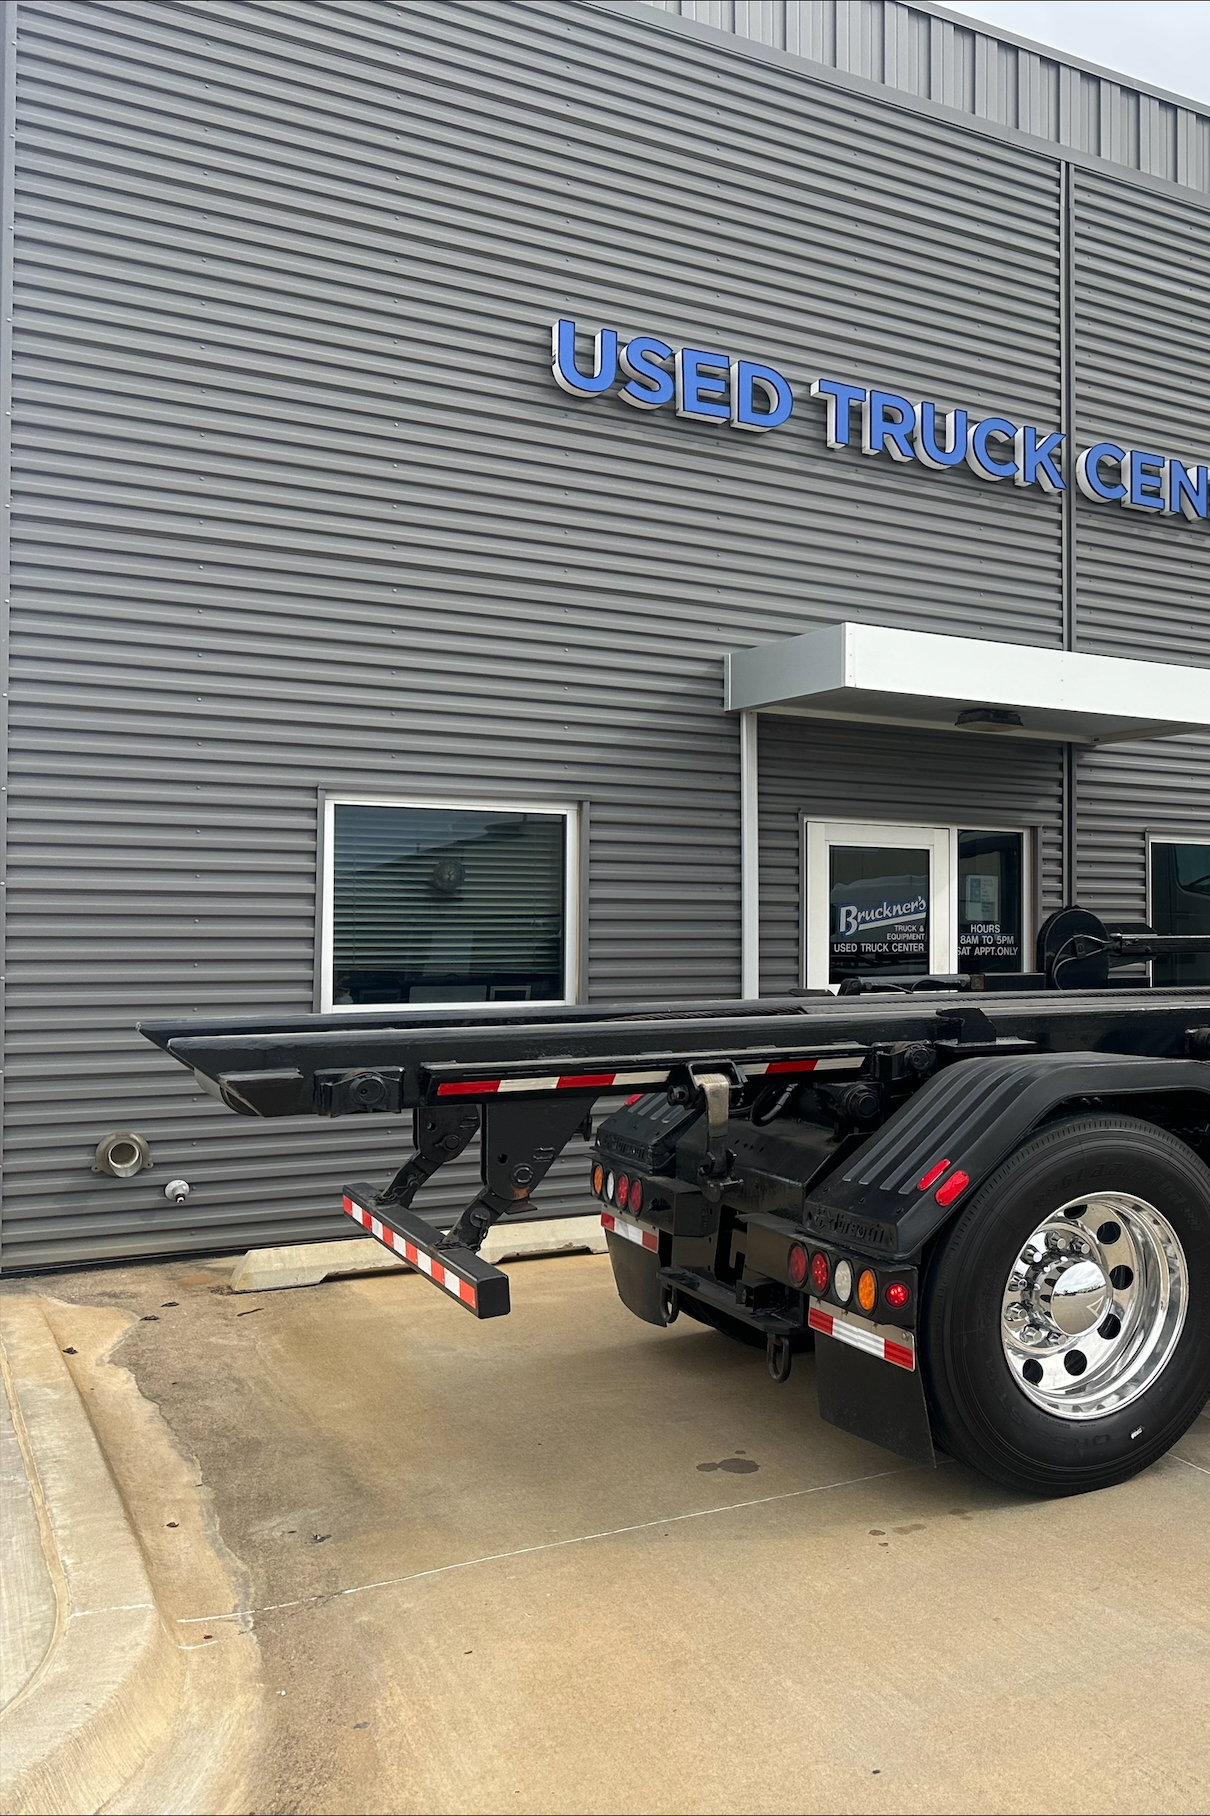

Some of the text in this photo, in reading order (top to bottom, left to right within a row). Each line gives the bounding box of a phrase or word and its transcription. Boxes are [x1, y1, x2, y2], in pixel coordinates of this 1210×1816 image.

[551, 318, 793, 433] USED
[810, 378, 1066, 492] TRUCK
[839, 896, 926, 936] Bruckner's
[894, 925, 917, 933] TRUCK
[970, 924, 1001, 934] HOURS
[886, 932, 925, 941] EQUIPMENT
[960, 935, 1014, 945] 8AM TO 5PM
[834, 943, 924, 953] USED TRUCK CENTER
